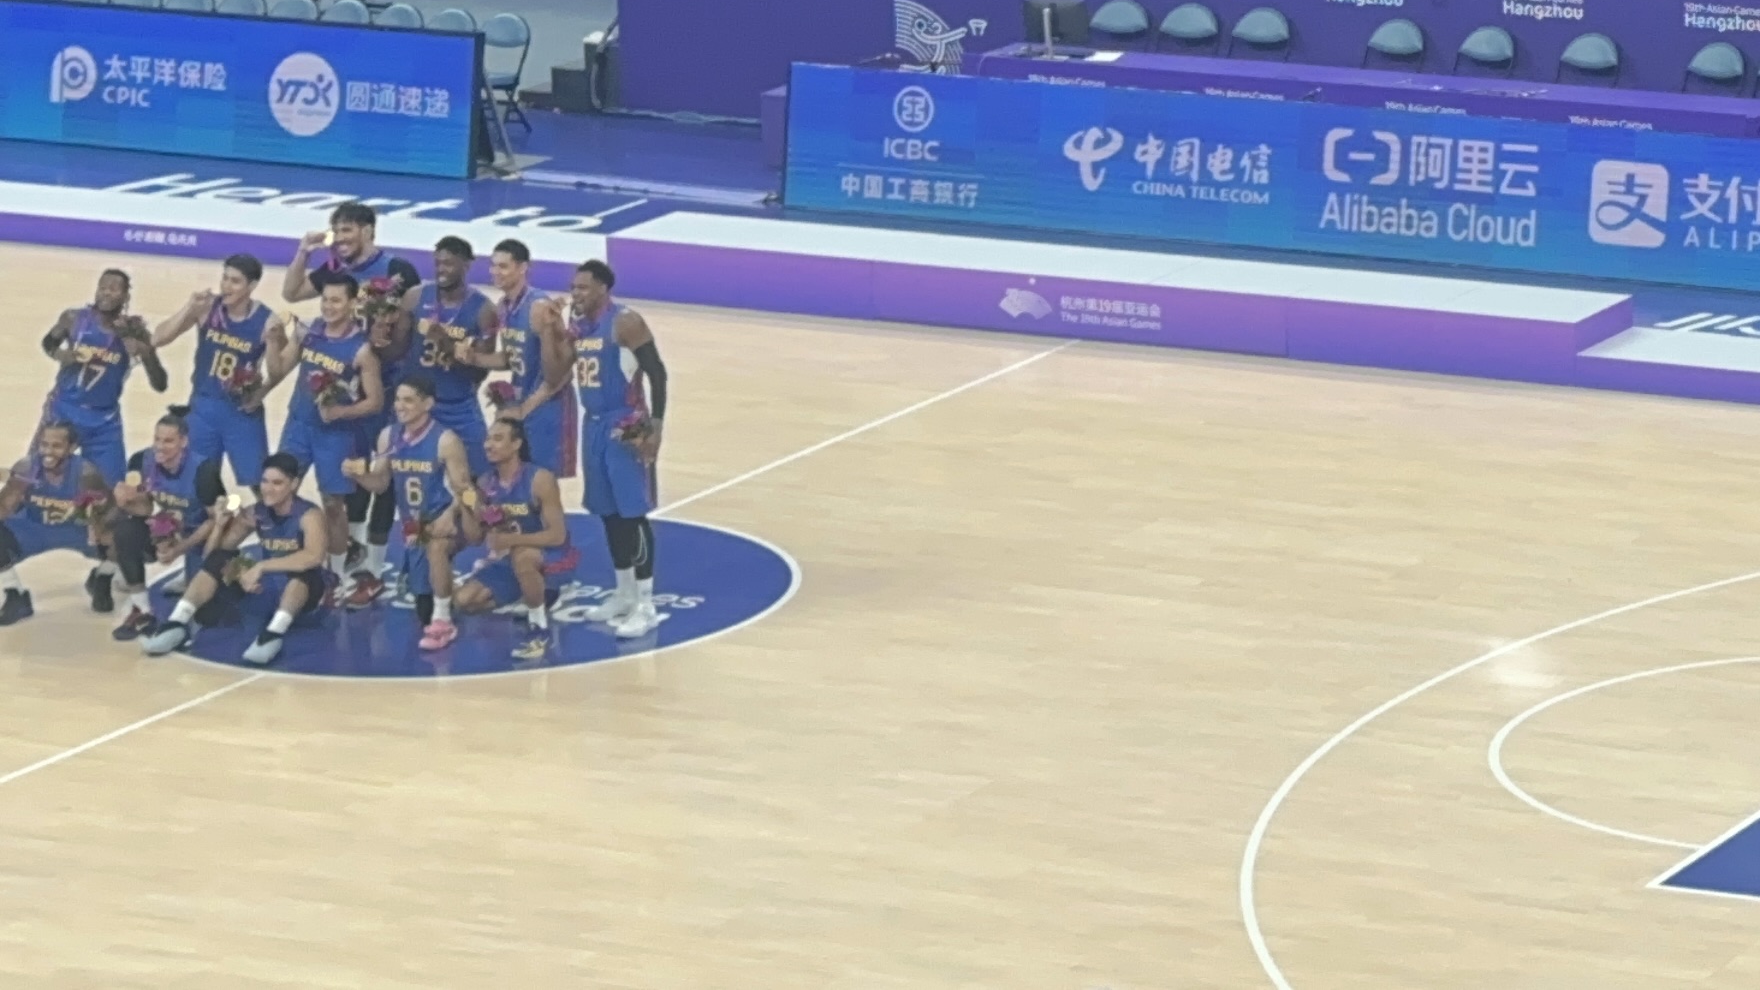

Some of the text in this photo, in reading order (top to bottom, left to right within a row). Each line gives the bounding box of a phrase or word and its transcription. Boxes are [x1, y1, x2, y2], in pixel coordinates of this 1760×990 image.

[1502, 0, 1585, 20] Hangzhou
[102, 53, 227, 91] 太平洋保险
[102, 85, 151, 108] CPIC
[345, 80, 451, 119] 圆通速递
[883, 137, 941, 161] ICBC
[1132, 132, 1274, 186] 中国电信
[1408, 134, 1540, 198] 阿里云
[840, 173, 979, 208] 中国工商银行
[1131, 179, 1270, 206] CHINA TELECOM
[1318, 190, 1536, 248] Alibaba Cloud
[1060, 312, 1079, 324] The
[205, 328, 252, 354] PILIPINAS
[208, 350, 238, 381] 18
[302, 347, 345, 375] PILIPINAS
[391, 458, 433, 474] PILIPINAS
[405, 476, 423, 506] 6
